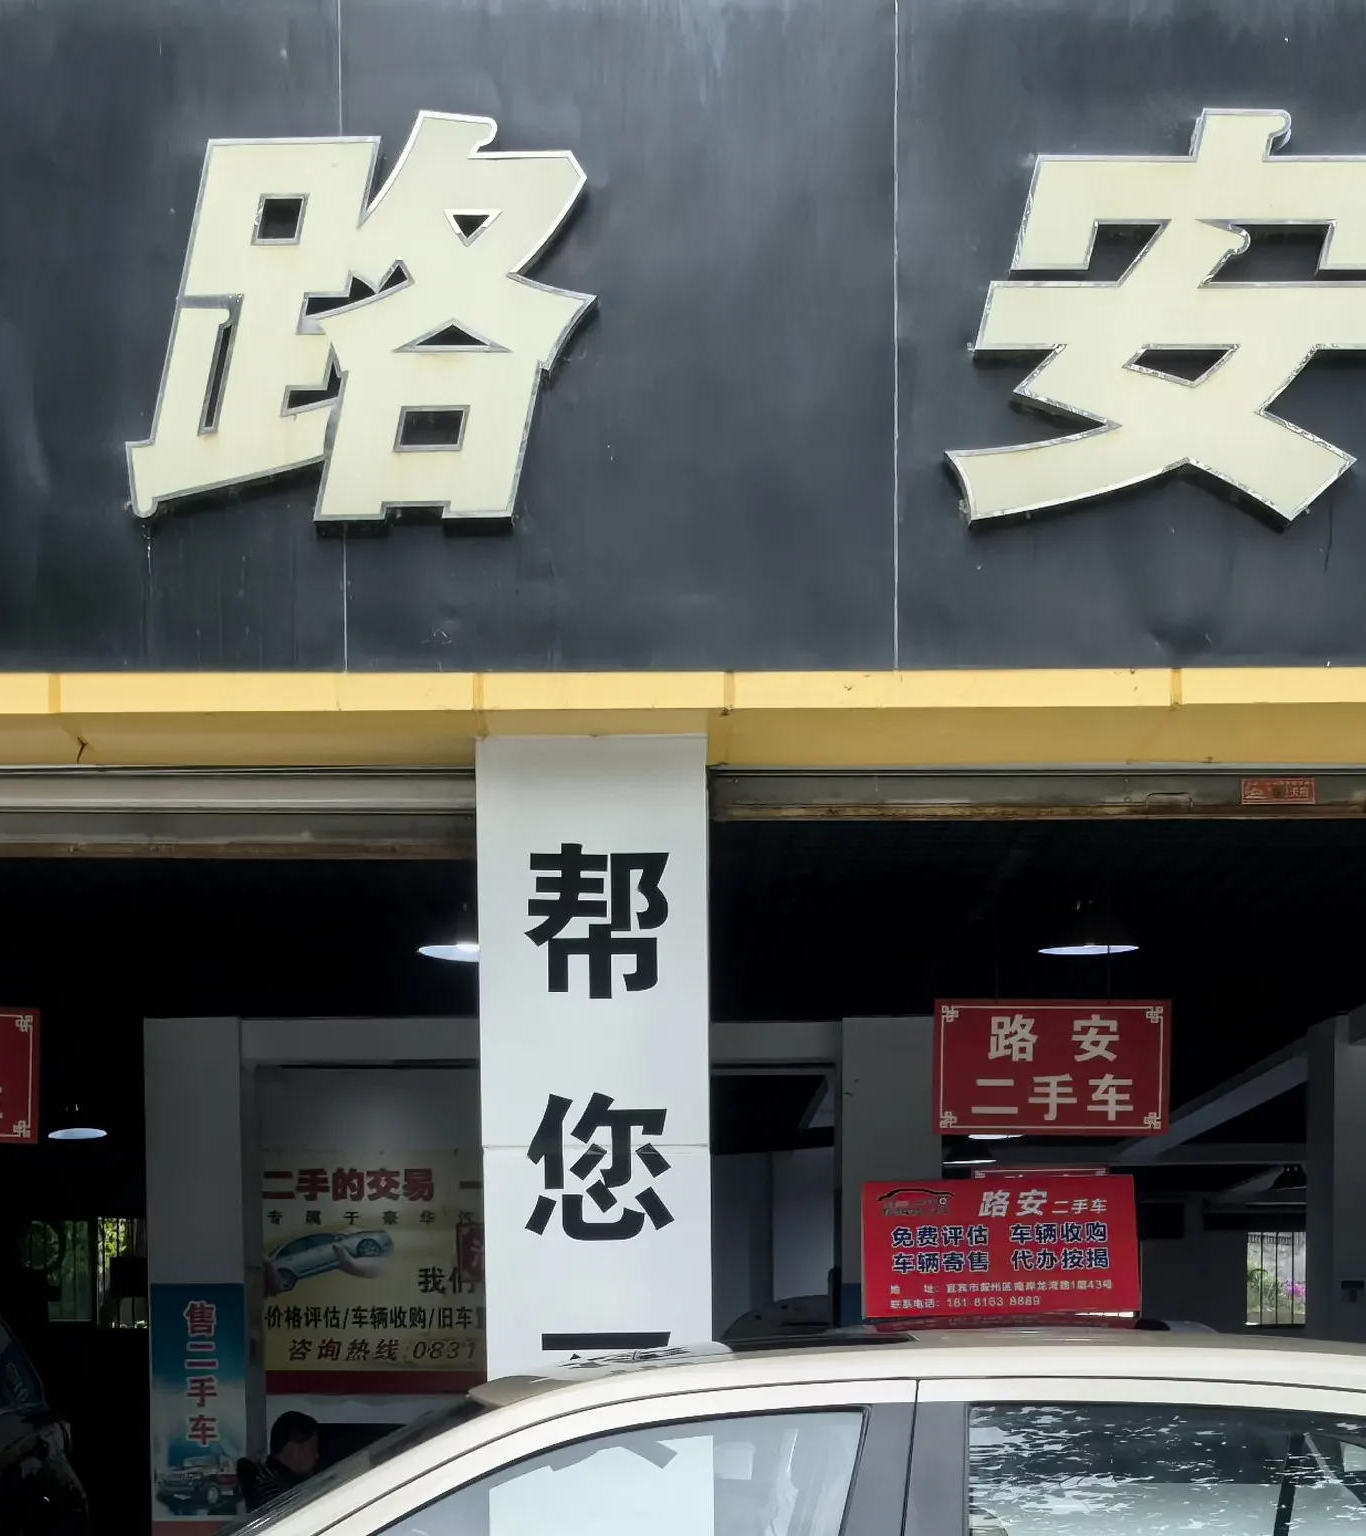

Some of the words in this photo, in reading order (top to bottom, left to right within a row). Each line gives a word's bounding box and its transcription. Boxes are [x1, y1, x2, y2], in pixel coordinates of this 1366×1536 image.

[987, 1013, 1121, 1063] 路安
[971, 1073, 1134, 1122] 二手车
[262, 1168, 434, 1201] 二手的交易
[891, 1225, 989, 1248] 免费评估
[1009, 1221, 1109, 1245] 车辆收购
[892, 1251, 989, 1274] 车辆寄售
[1011, 1248, 1110, 1271] 代办按揭
[183, 1300, 219, 1447] 售二手车
